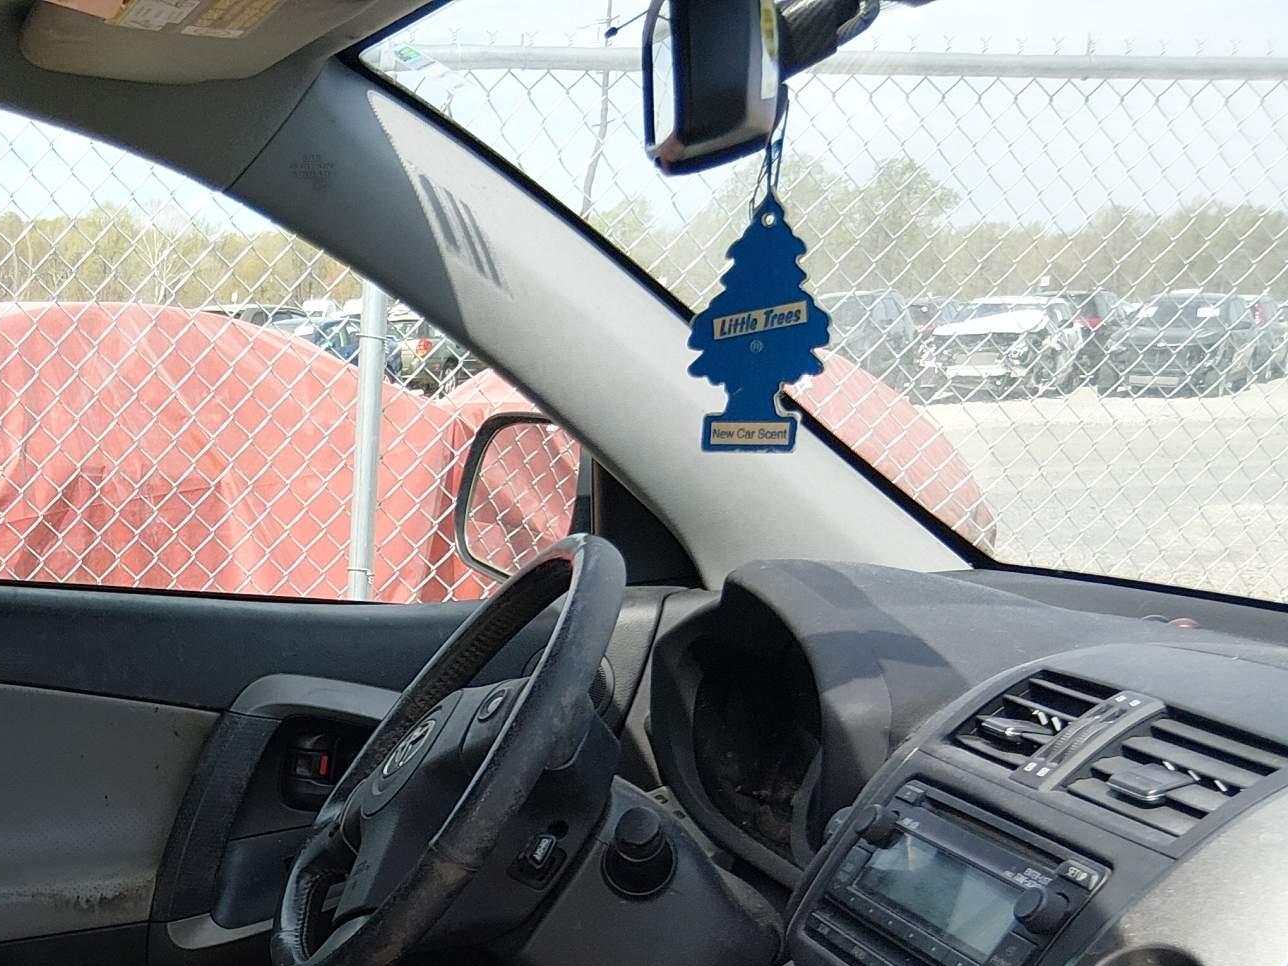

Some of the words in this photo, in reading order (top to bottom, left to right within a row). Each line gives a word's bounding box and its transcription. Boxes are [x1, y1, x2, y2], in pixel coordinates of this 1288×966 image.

[719, 314, 758, 337] Little
[763, 308, 802, 327] Trees
[712, 429, 733, 439] New
[736, 428, 755, 439] Car
[758, 428, 787, 439] Scent
